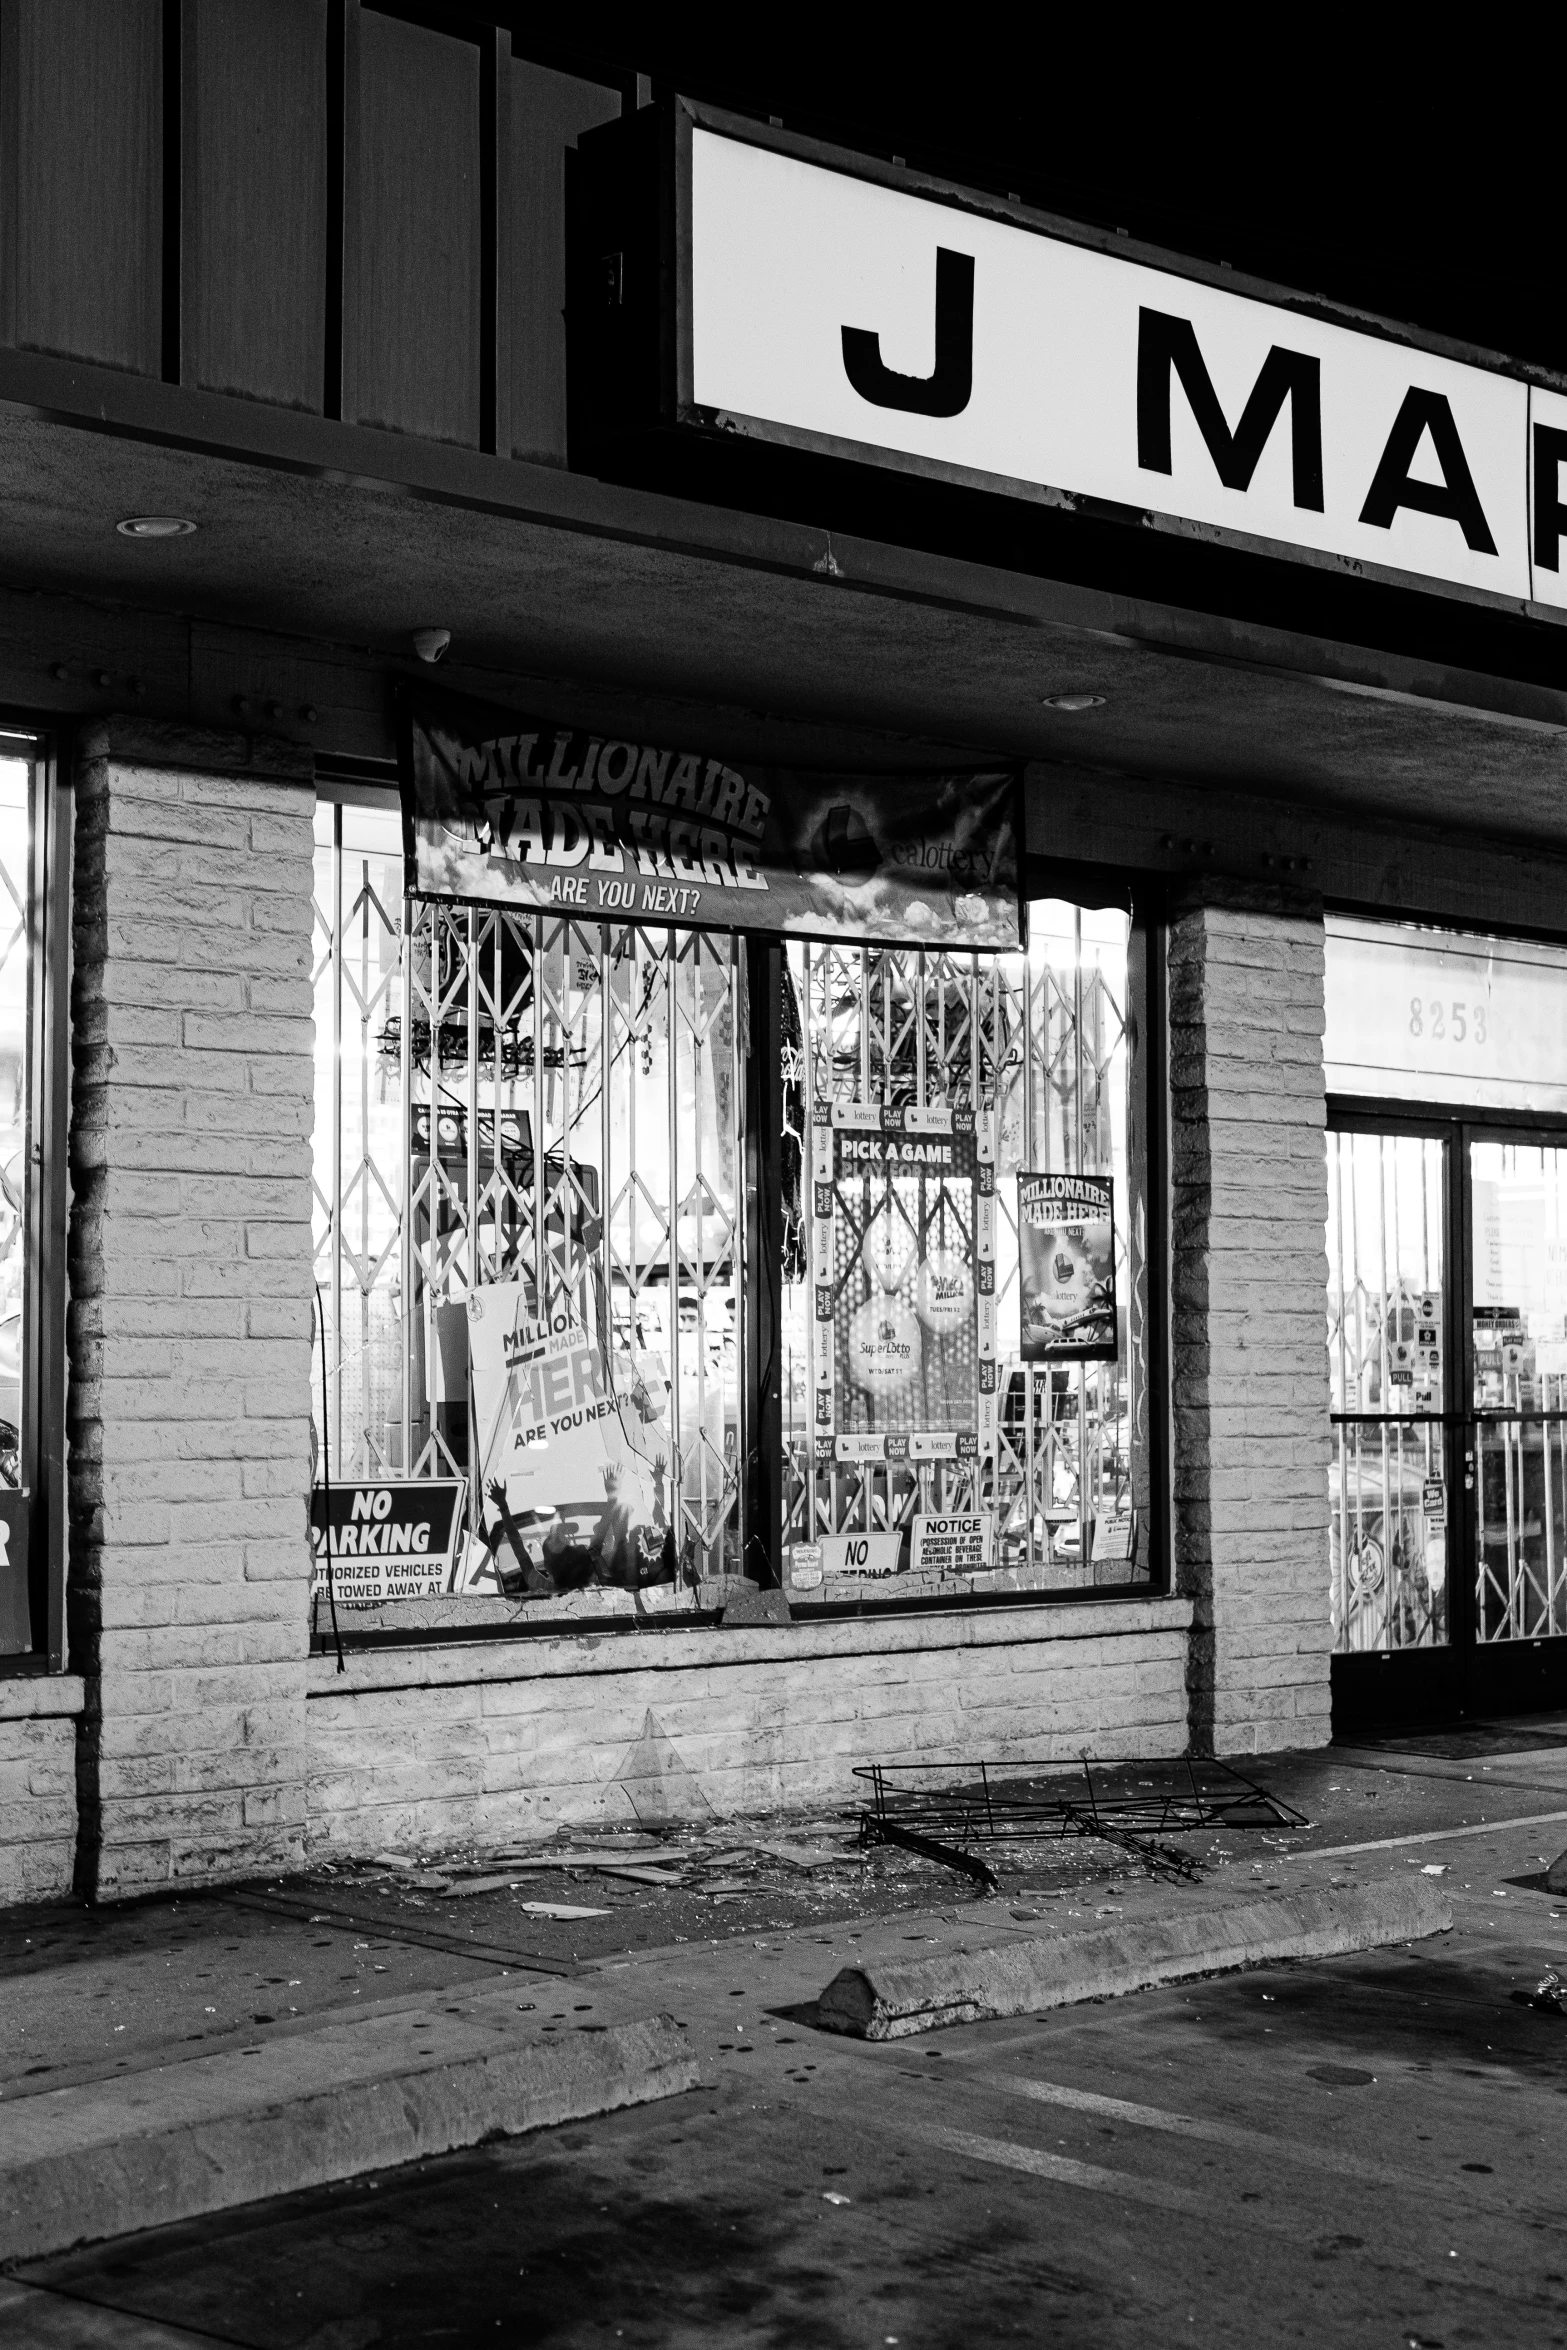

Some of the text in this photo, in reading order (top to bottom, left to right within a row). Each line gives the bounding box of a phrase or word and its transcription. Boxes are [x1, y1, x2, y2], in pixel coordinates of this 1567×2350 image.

[841, 245, 1567, 573] J MA
[456, 731, 772, 840] MILLIONAIRE
[462, 798, 770, 891] MADE HERE
[550, 875, 701, 916] ARE YOU NEXT?
[1408, 997, 1488, 1045] 8253
[813, 1105, 829, 1115] LAY
[854, 1110, 878, 1123] lottery
[883, 1110, 902, 1119] PLAY
[955, 1114, 973, 1123] PLAY
[884, 1118, 902, 1127] NOW
[926, 1114, 949, 1127] lottery
[956, 1122, 973, 1131] NOW
[819, 1126, 827, 1152] lotter
[841, 1140, 952, 1164] PICK A GAME
[1020, 1176, 1110, 1208] MILLIONAIRE
[983, 1201, 991, 1231] lottery
[1020, 1200, 1111, 1227] MADE HERE
[820, 1223, 829, 1254] lottery
[983, 1300, 992, 1330] lottery
[549, 1329, 585, 1354] MADE
[820, 1327, 829, 1358] lottery
[860, 1341, 911, 1358] SuperLotto
[1392, 1373, 1412, 1383] PULL
[1416, 1391, 1432, 1401] Pull
[818, 1393, 826, 1419] PLAY
[983, 1399, 992, 1429] lottery
[514, 1424, 547, 1450] ARE
[550, 1410, 583, 1435] YOU
[858, 1441, 882, 1453] lottery
[887, 1438, 907, 1447] PLAY
[931, 1439, 953, 1451] lottery
[959, 1437, 978, 1446] PLAY
[960, 1445, 977, 1454] NOW
[888, 1447, 906, 1456] NOW
[351, 1490, 393, 1521] NO
[926, 1519, 982, 1533] NOTICE
[960, 1536, 966, 1545] OF
[969, 1535, 983, 1544] OPEN
[844, 1539, 869, 1567] NO
[955, 1544, 983, 1554] BEVERAGE
[921, 1553, 983, 1565] CONTAINER ON THESE
[315, 1563, 443, 1581] THORIZED VEHICLES
[338, 1584, 382, 1598] TOWED
[387, 1581, 423, 1596] AWAY
[428, 1581, 442, 1594] AT
